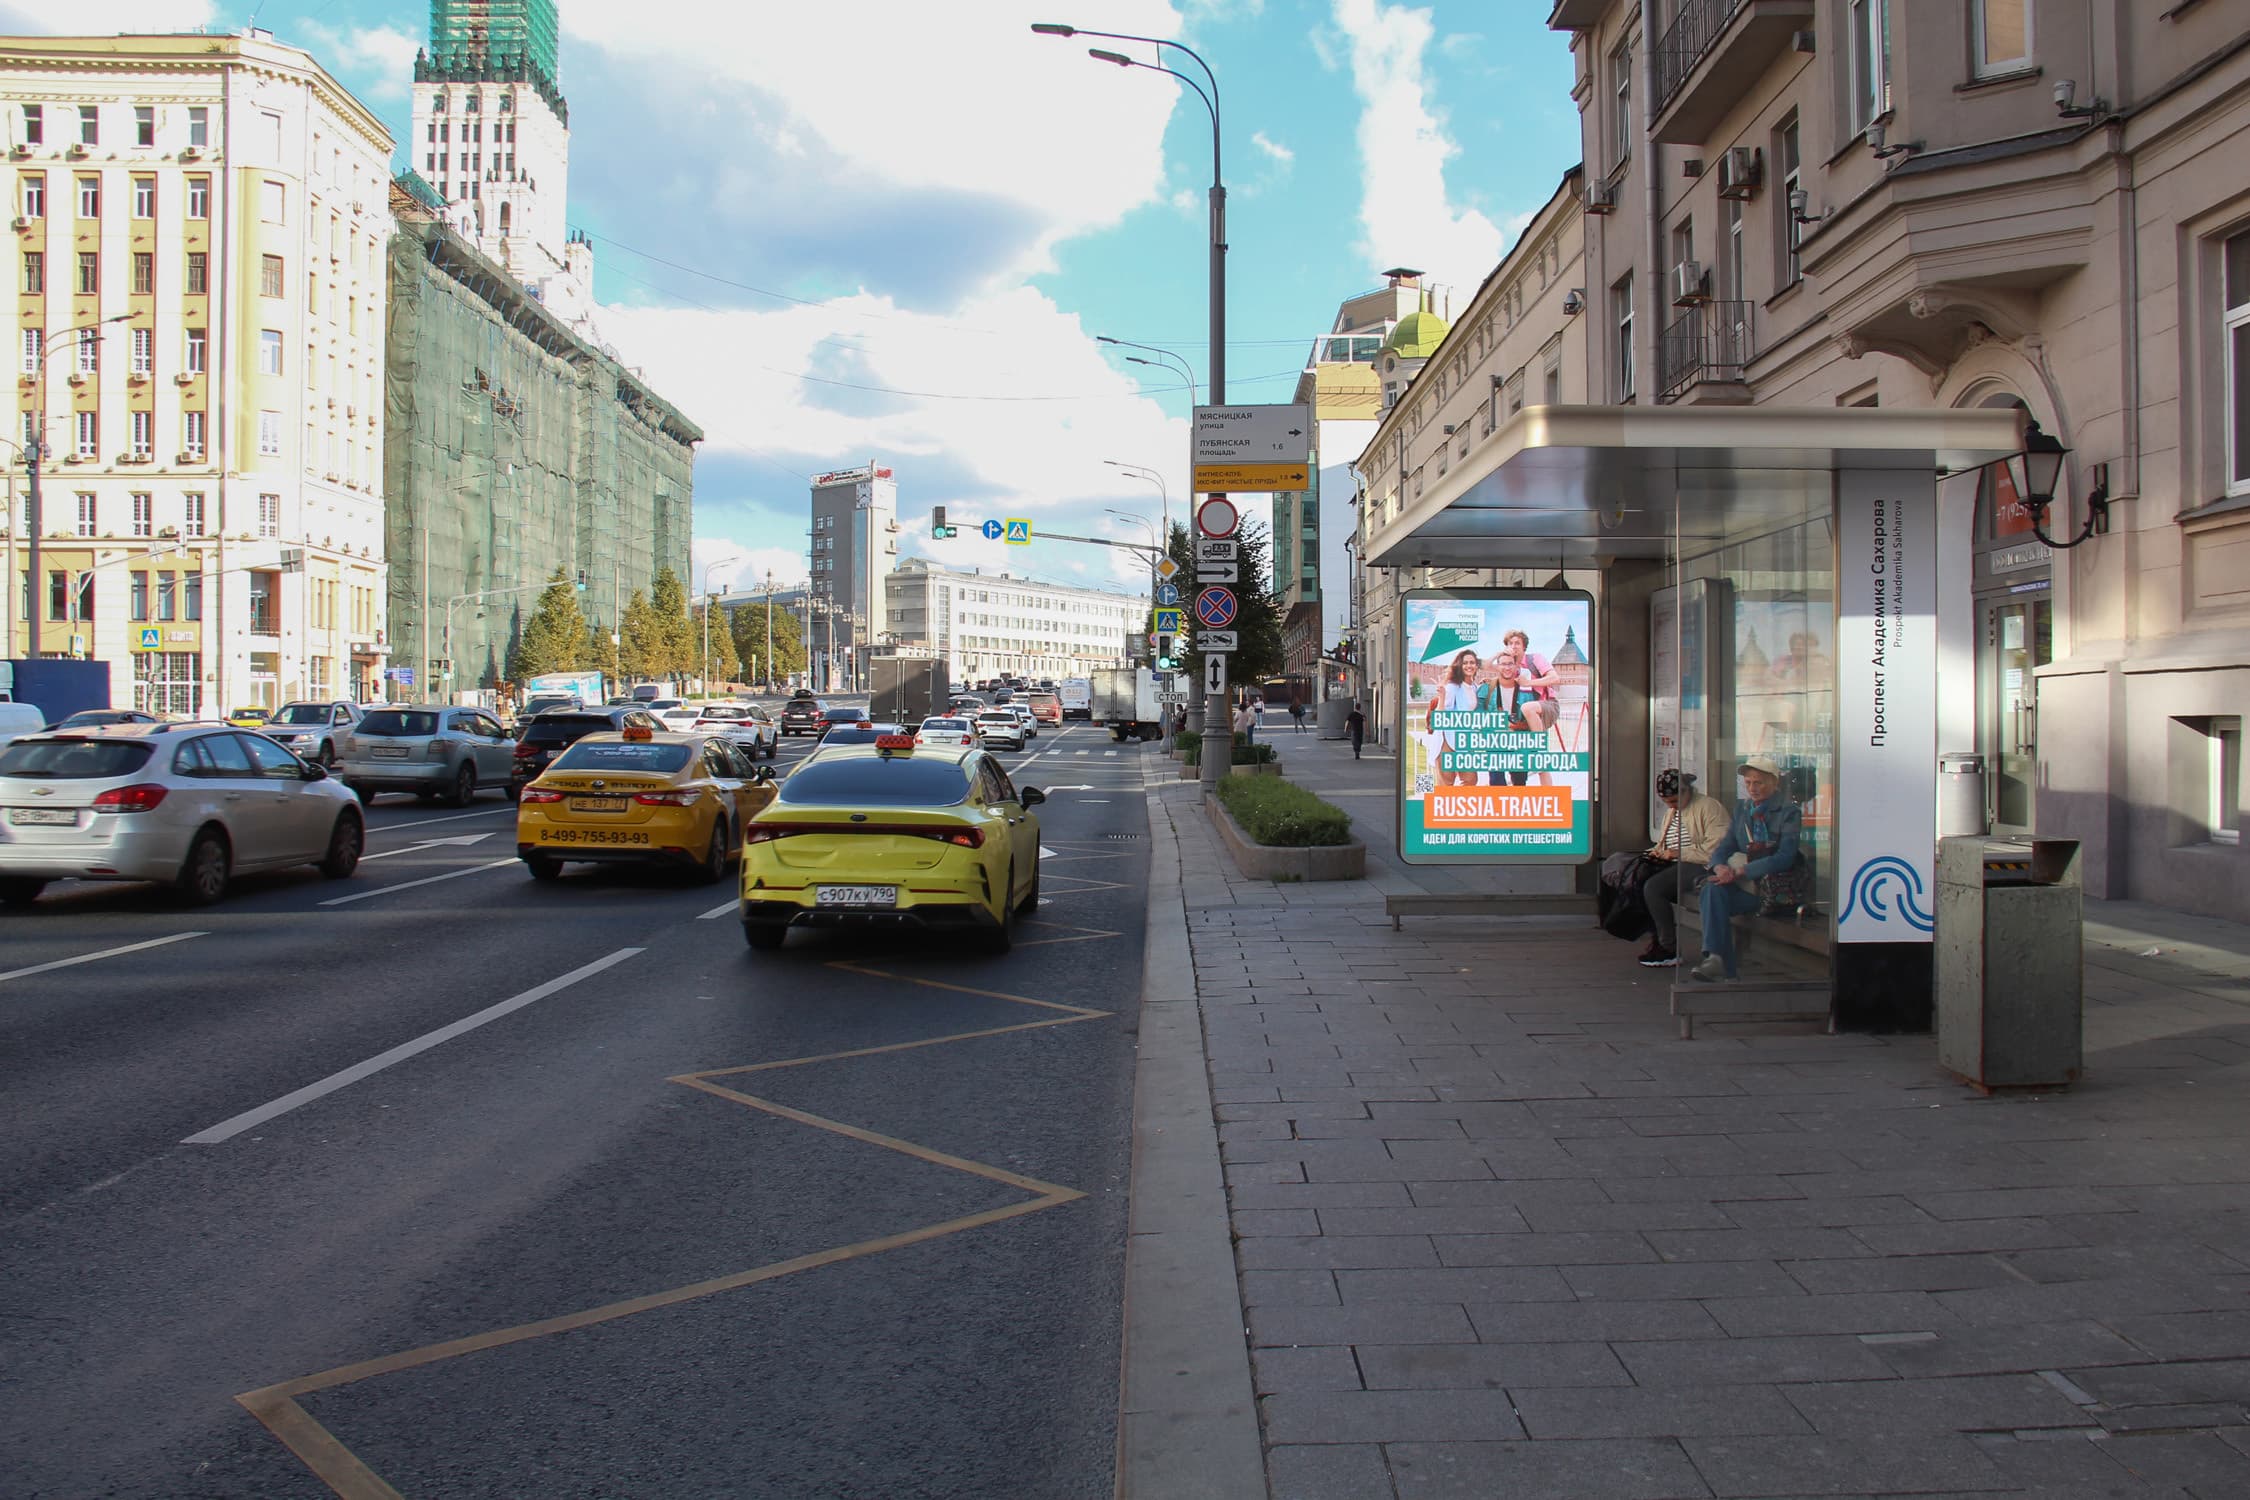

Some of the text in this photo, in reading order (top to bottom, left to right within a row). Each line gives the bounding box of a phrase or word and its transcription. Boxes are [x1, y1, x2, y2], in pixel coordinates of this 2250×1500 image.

[1200, 412, 1253, 420] МЯСНИЦКАЯ
[1893, 500, 1904, 648] Prospekt Akademika Sakharova
[1871, 499, 1887, 747] Проспект Академика Сахарова
[1158, 693, 1183, 701] СТОП
[1434, 711, 1506, 729] ВЫХОДИТЕ
[1459, 732, 1546, 750] В ВЫХОДНЫЕ
[1444, 753, 1578, 771] В СОСЕДНИЕ ГОРОДА
[592, 799, 608, 808] 137
[1433, 796, 1563, 817] RUSSIA.TRAVEL
[540, 829, 649, 844] 8-499-755-93-93
[1423, 831, 1572, 844] ИДЕИ ДЛЯ КОРОТКИХ ПУТЕШЕСТВИЙ
